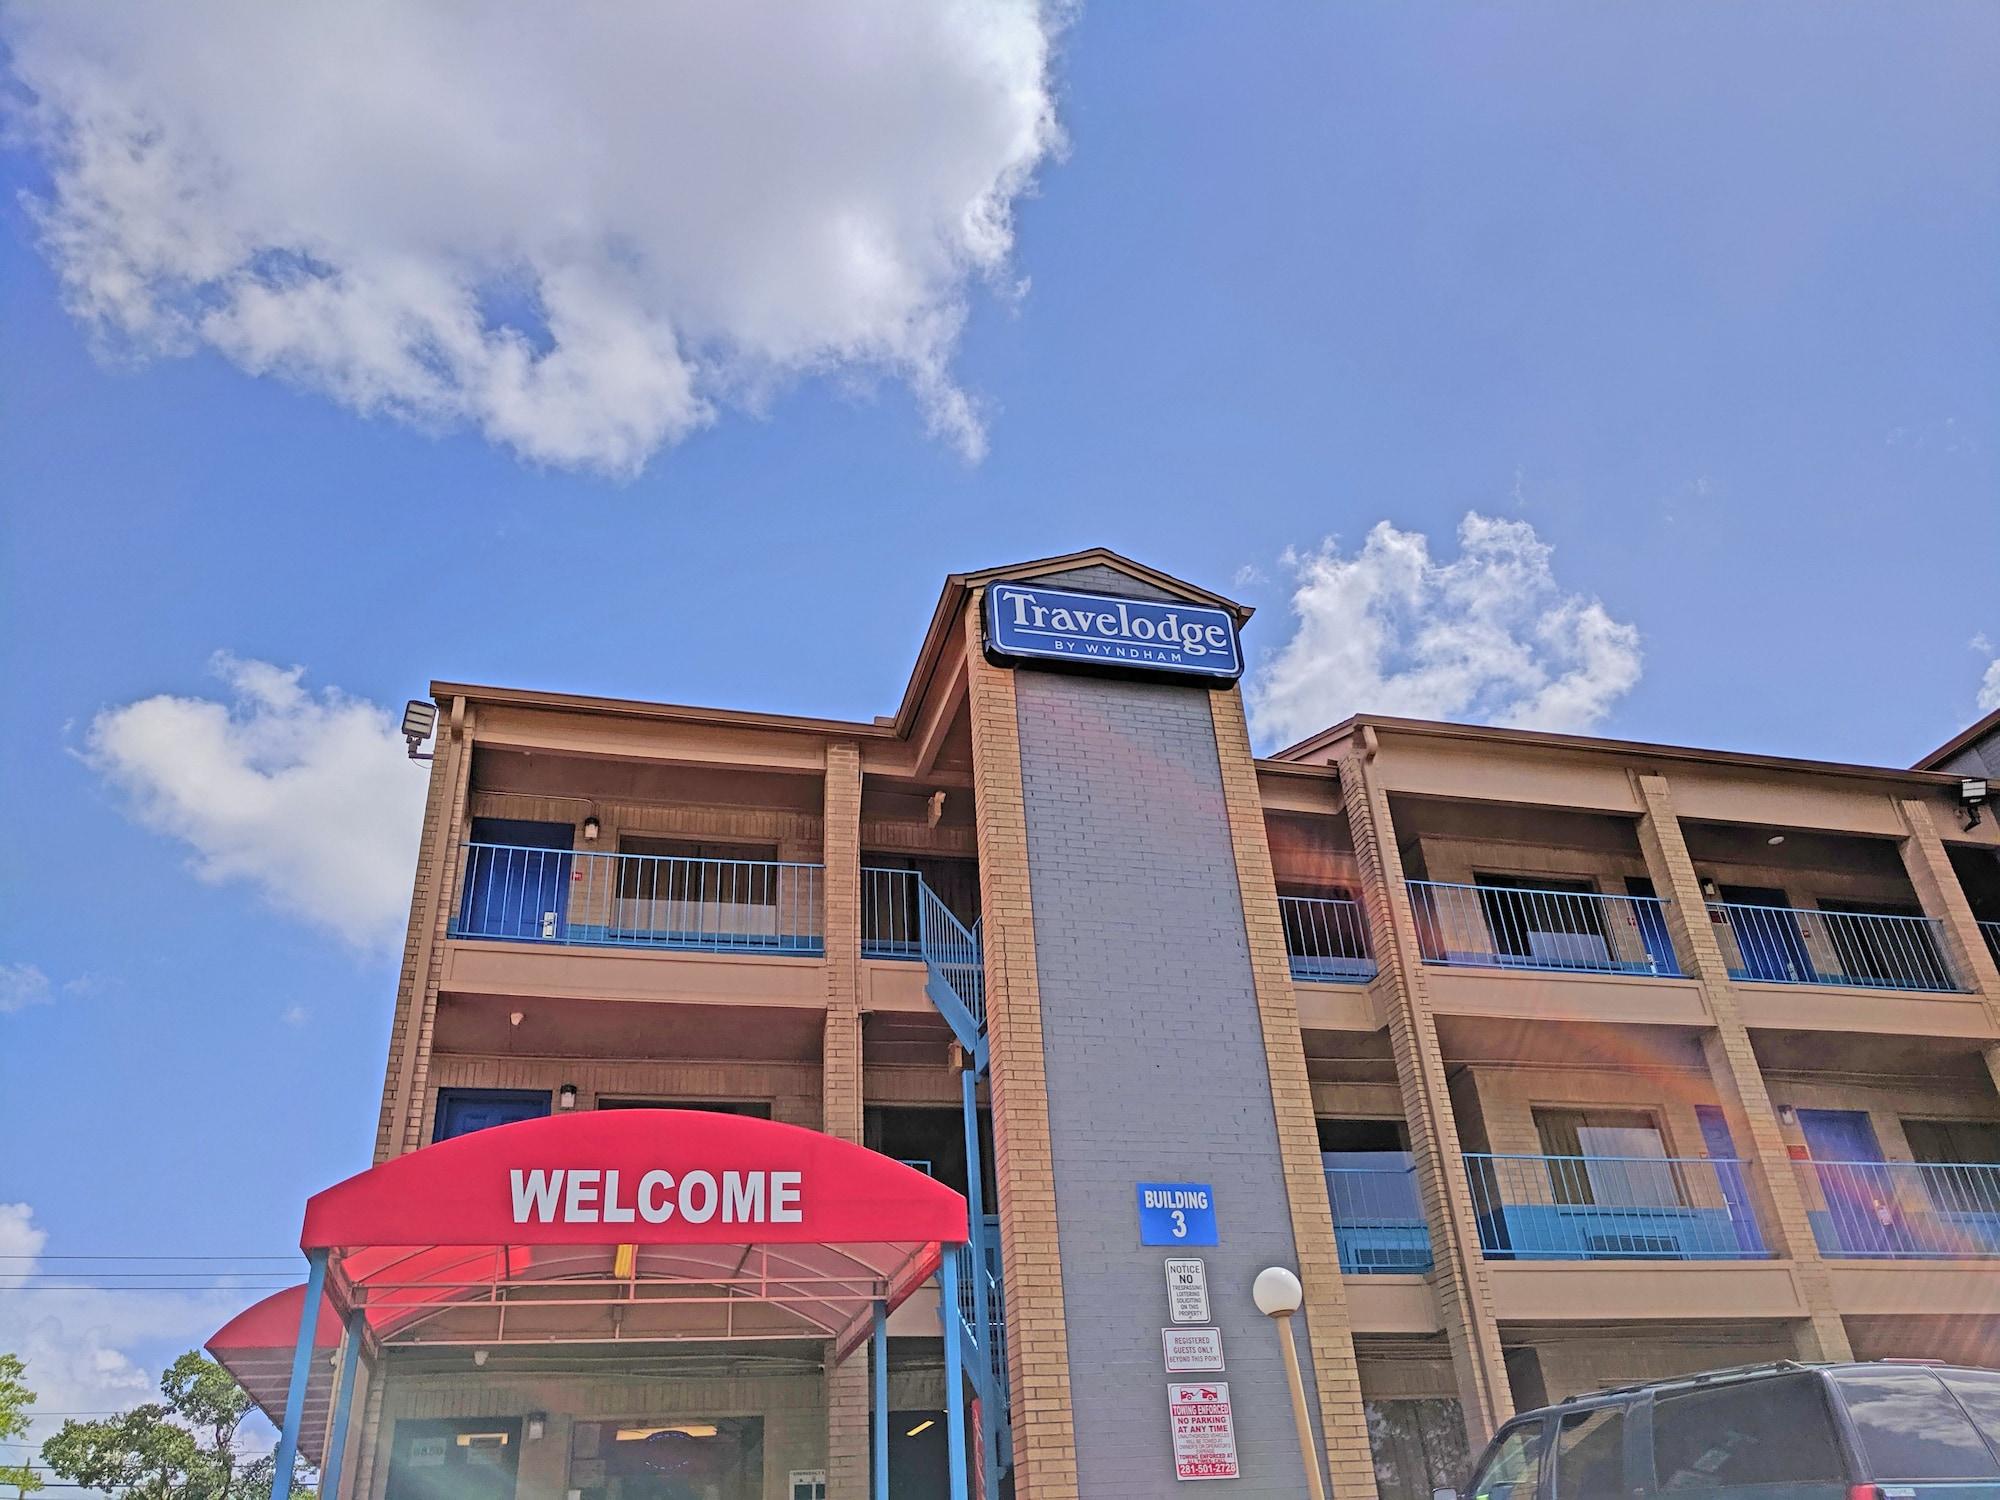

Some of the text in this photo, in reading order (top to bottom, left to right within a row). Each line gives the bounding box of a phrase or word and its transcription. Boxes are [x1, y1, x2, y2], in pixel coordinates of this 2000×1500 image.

[1002, 591, 1227, 656] Travelodge
[1054, 640, 1182, 662] BY WYNDHAM
[509, 1168, 803, 1224] WELCOME
[1144, 1190, 1208, 1209] BUILDING
[1171, 1210, 1187, 1238] 3
[1170, 1265, 1201, 1274] NOTICE
[1179, 1274, 1193, 1284] NO
[1173, 1346, 1213, 1354] GUESTS ONLY
[1173, 1404, 1229, 1415] TOWING ENFORCED
[1178, 1416, 1226, 1425] NO PARKING
[1180, 1463, 1236, 1474] 281-501-2728
